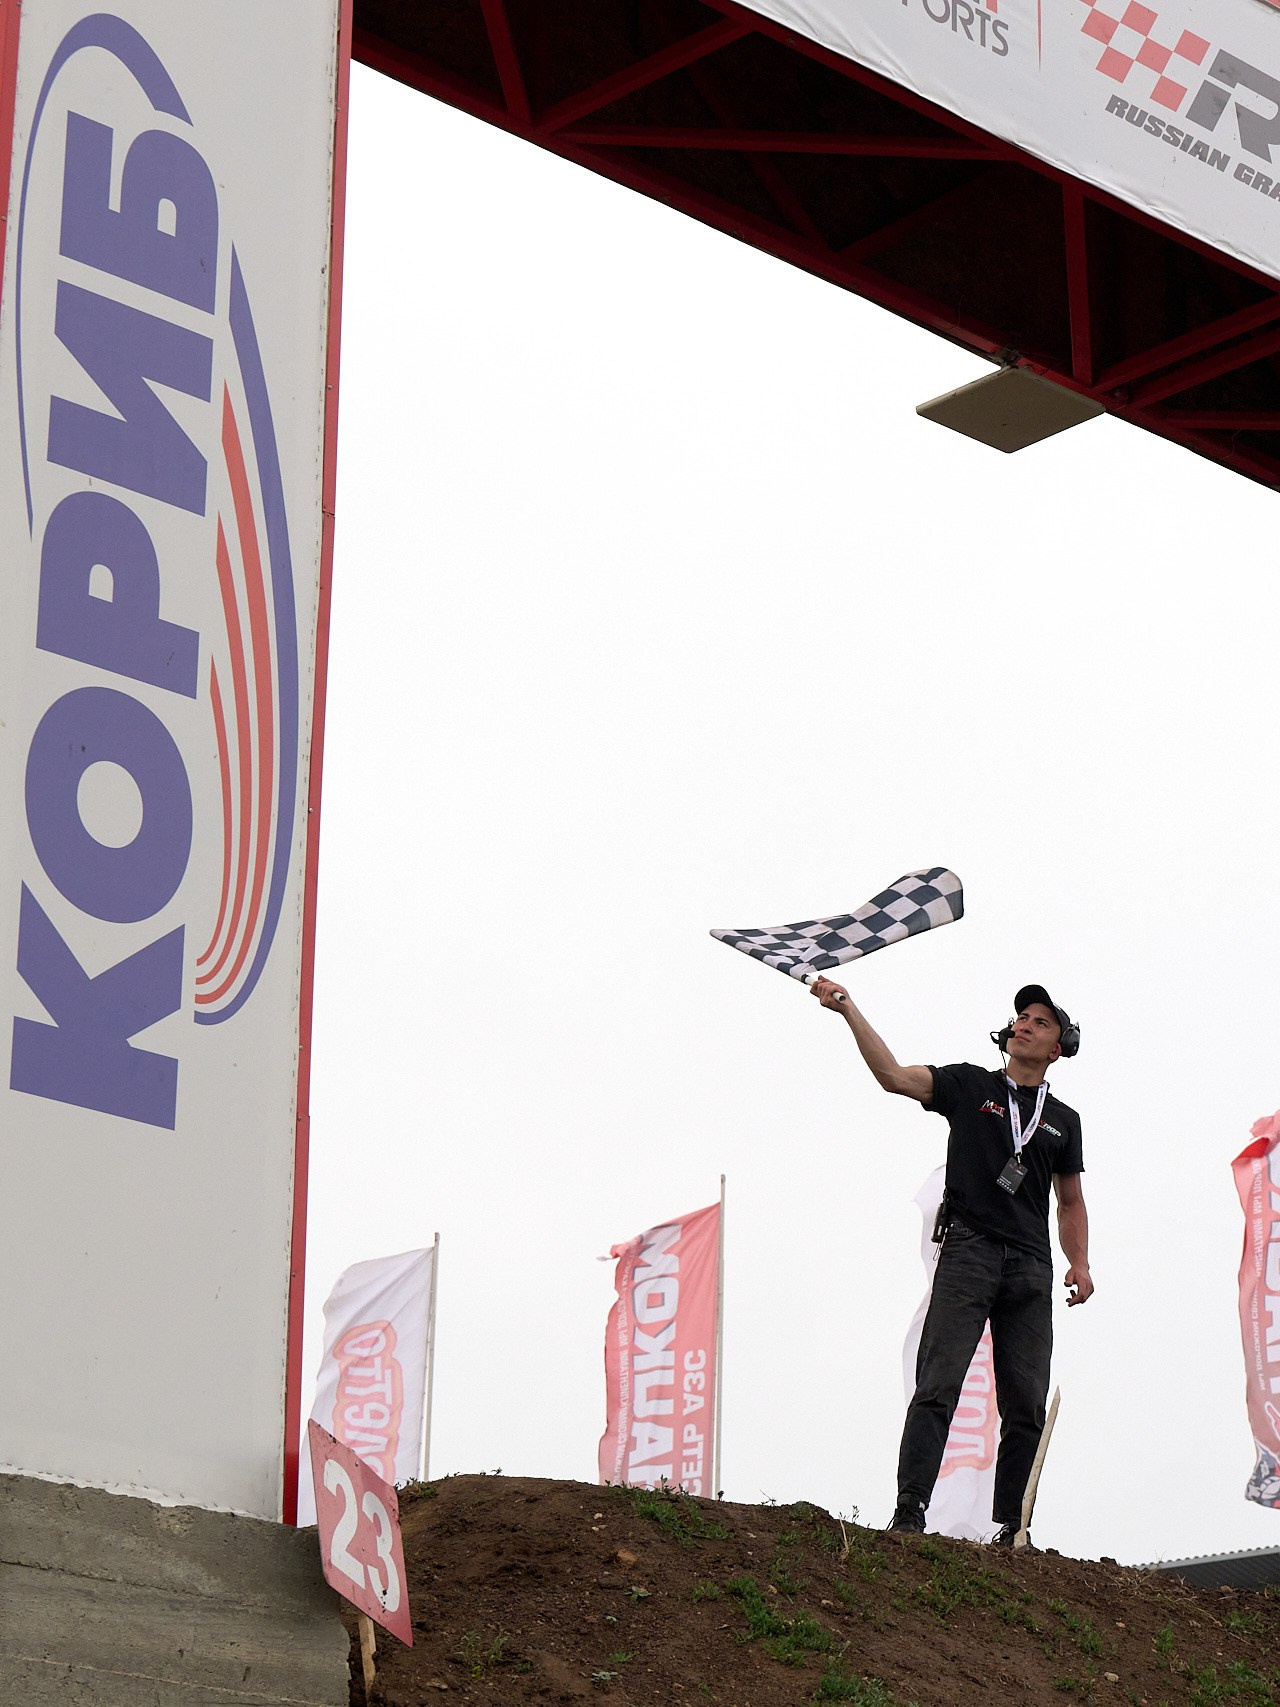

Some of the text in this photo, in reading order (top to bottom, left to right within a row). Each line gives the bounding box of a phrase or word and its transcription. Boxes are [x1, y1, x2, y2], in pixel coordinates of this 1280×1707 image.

[1105, 94, 1231, 173] RUSSIAN
[9, 110, 220, 1131] КОРИБ
[323, 1458, 400, 1613] 23
